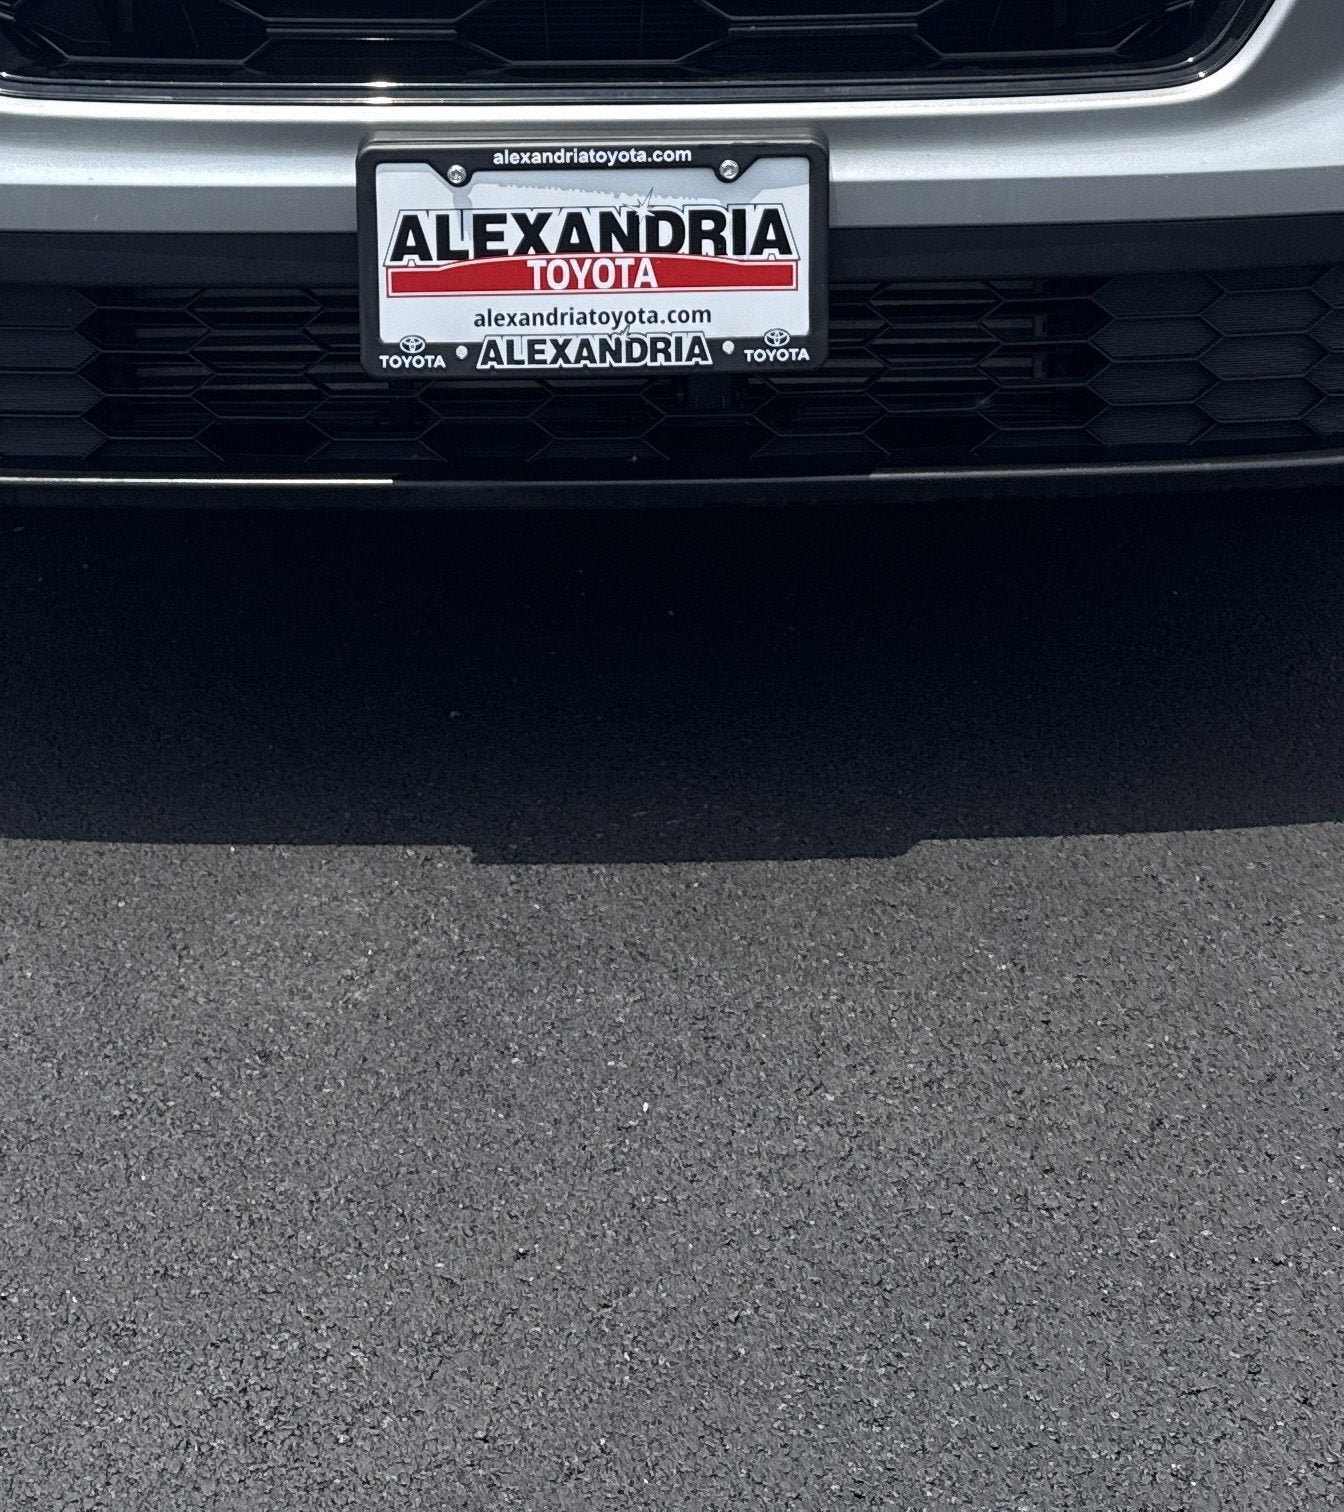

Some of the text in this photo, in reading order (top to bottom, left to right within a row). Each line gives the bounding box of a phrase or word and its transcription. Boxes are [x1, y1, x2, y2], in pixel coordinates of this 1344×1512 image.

[492, 147, 692, 167] alexandriatoyota.com
[388, 205, 794, 263] ALEXANDRIA
[526, 256, 659, 291] TOYOTA
[473, 306, 712, 331] alexandriatoyota.com
[379, 352, 447, 370] TOYOTA
[478, 334, 712, 368] ALEXANDRIA
[743, 346, 811, 364] TOYOTA
